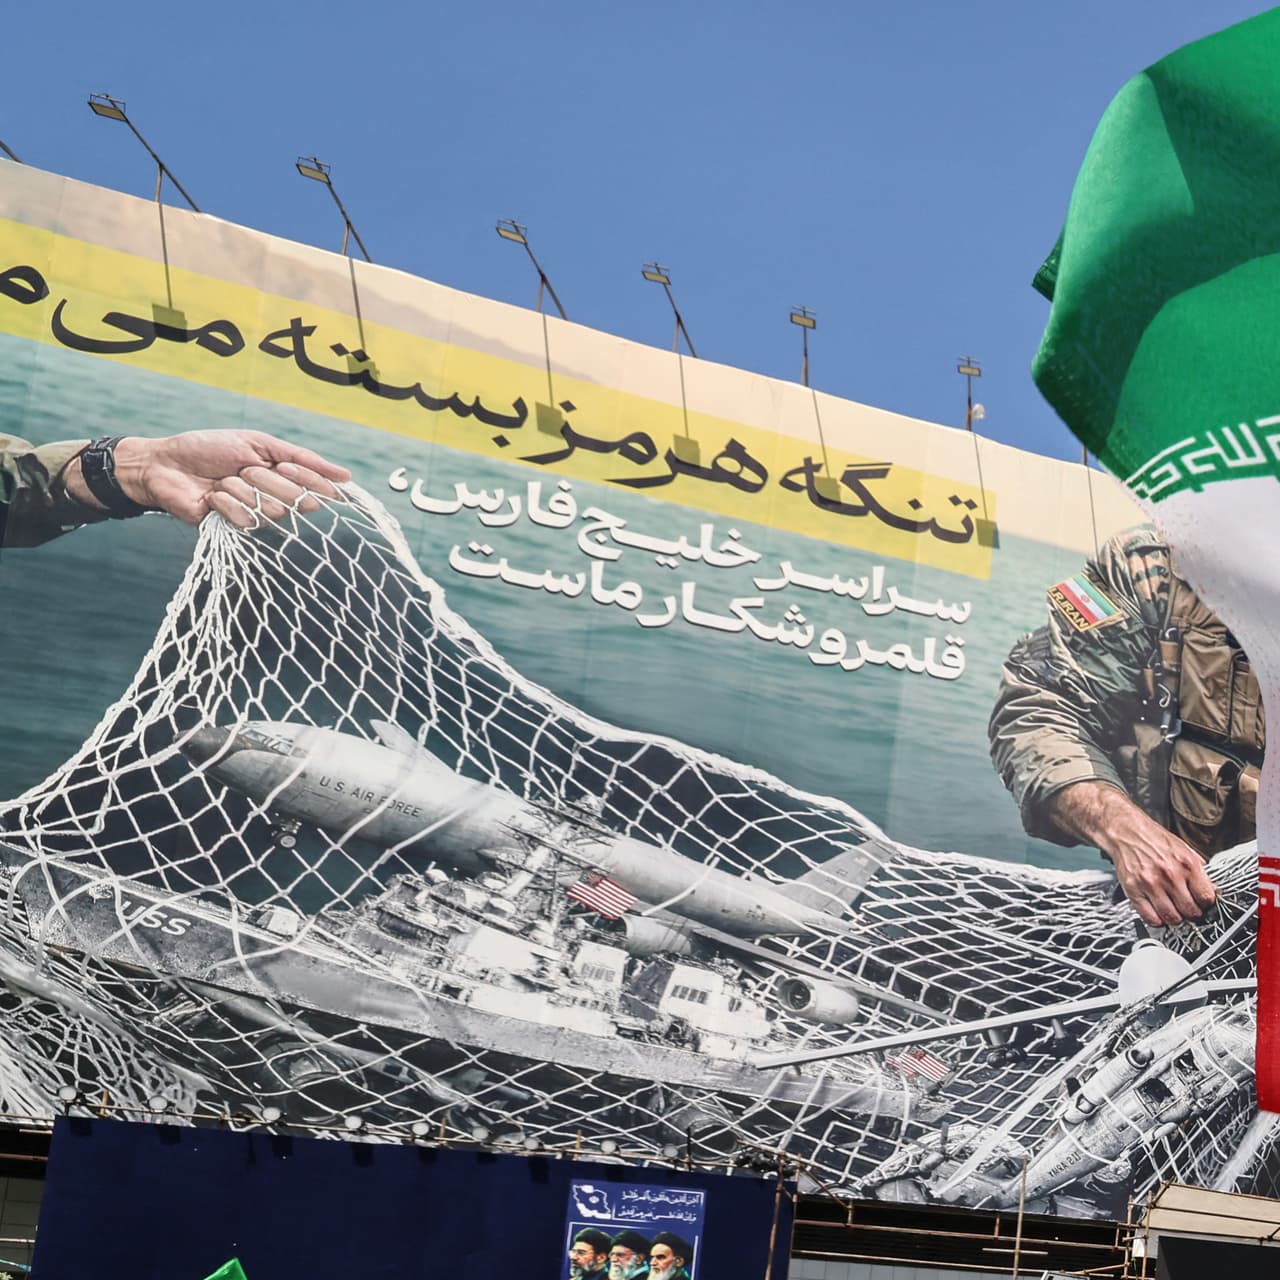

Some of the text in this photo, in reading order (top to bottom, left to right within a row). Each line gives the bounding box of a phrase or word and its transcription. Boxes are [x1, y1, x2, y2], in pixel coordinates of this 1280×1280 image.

[51, 299, 245, 357] می
[258, 316, 528, 448] بسته
[517, 400, 770, 492] هرمز
[780, 455, 979, 544] تنگه
[576, 504, 762, 567] خلیج
[447, 536, 967, 681] قلمرو شکار ماست
[754, 557, 973, 625] سراسر
[351, 787, 375, 803] AIR
[120, 901, 192, 935] USS
